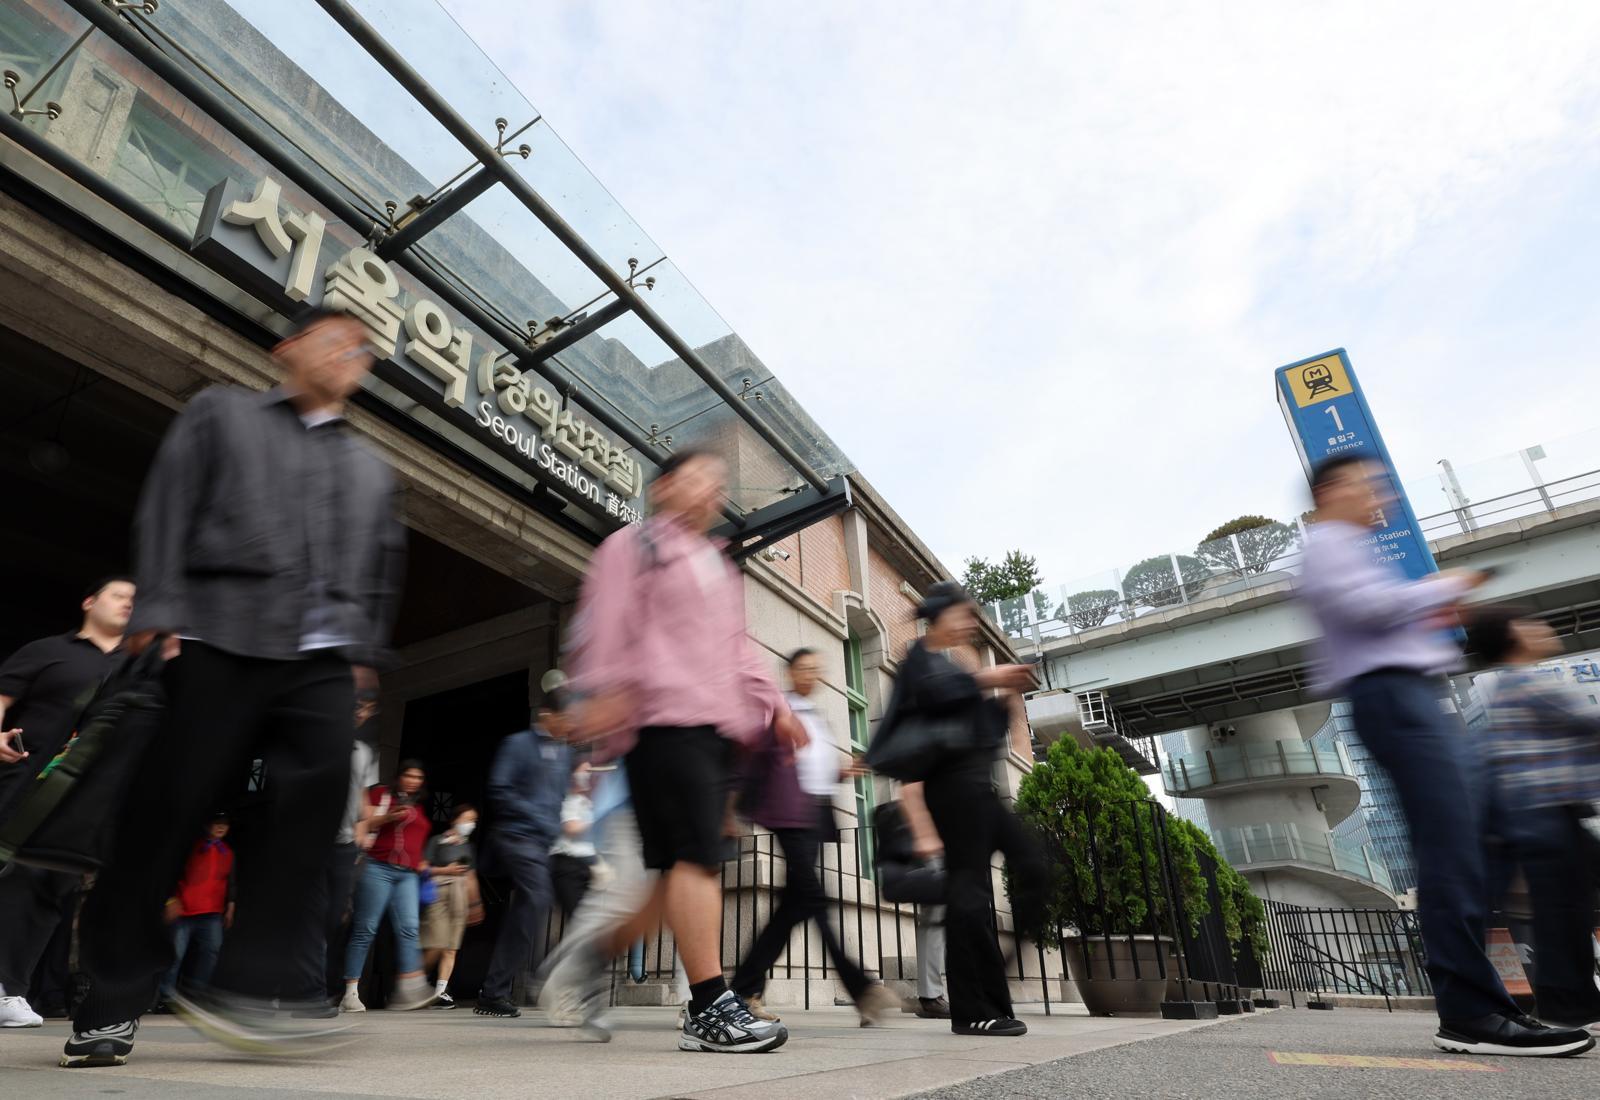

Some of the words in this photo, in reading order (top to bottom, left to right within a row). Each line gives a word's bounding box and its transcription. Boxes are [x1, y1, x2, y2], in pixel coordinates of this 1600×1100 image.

[221, 176, 472, 408] 서울역
[1324, 405, 1344, 431] 1
[1326, 440, 1364, 455] Entrance
[478, 401, 536, 459] Seoul
[539, 444, 600, 503] Station
[606, 492, 643, 527] 首尔站
[1379, 529, 1411, 541] Station
